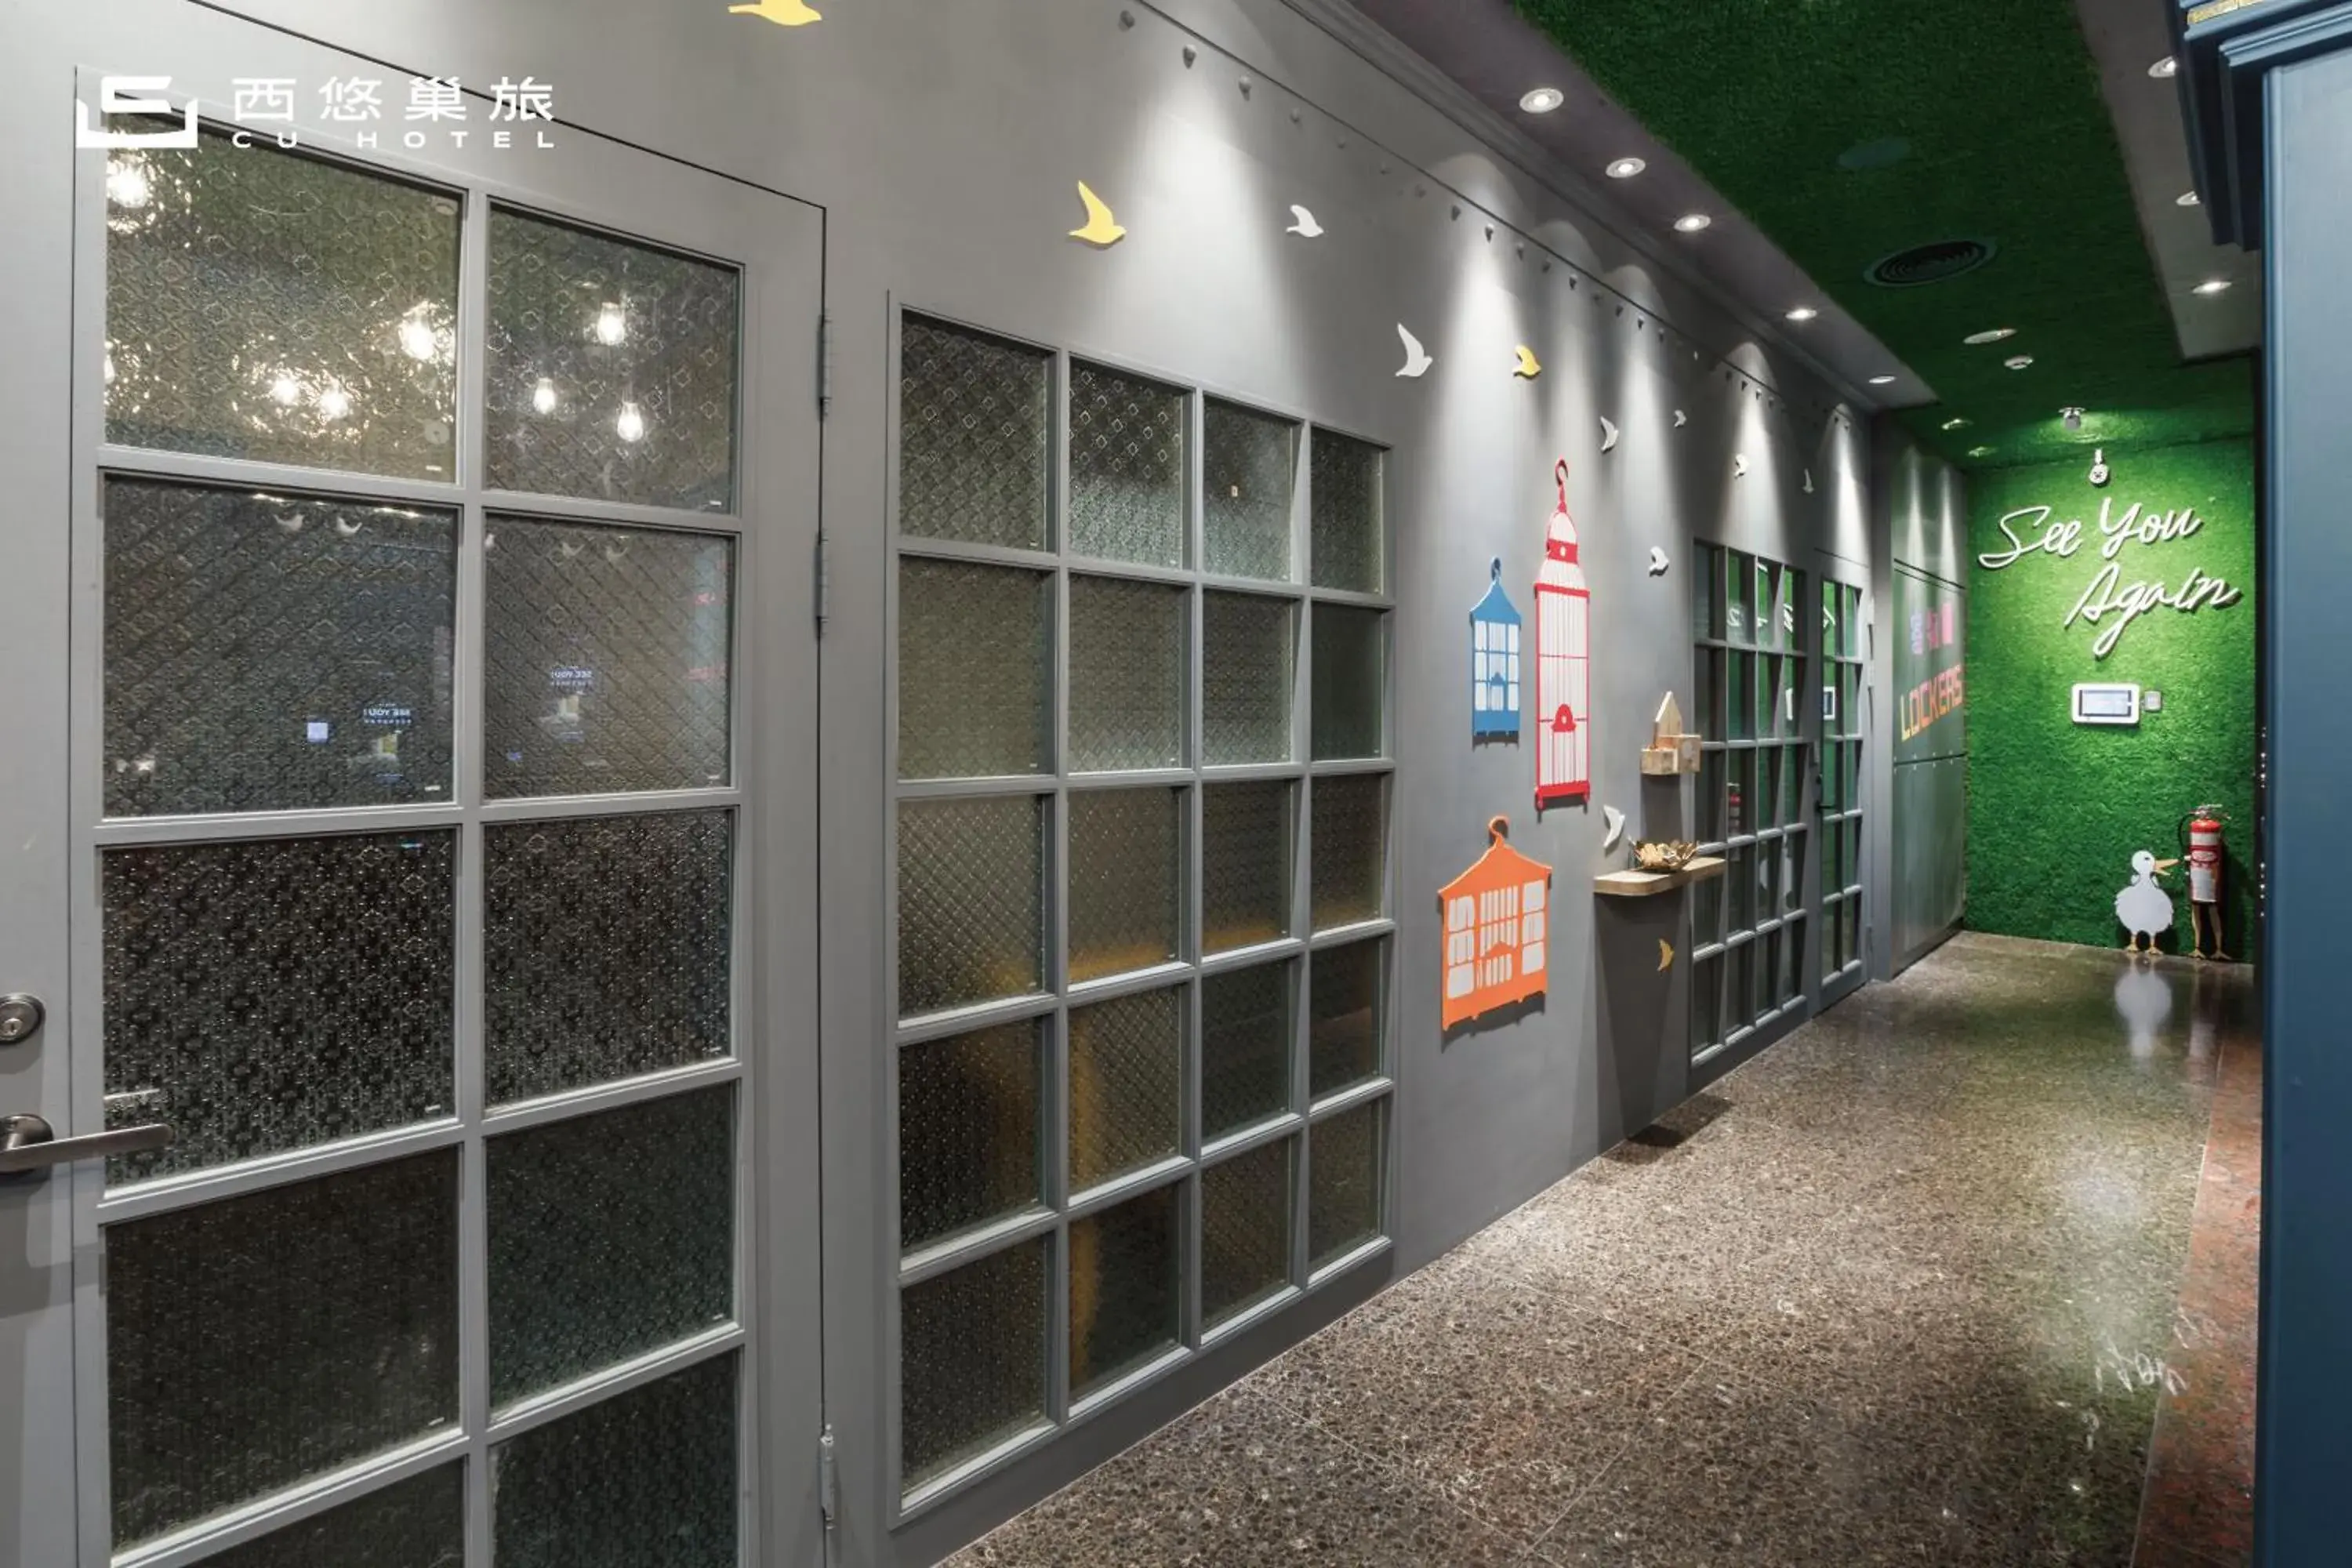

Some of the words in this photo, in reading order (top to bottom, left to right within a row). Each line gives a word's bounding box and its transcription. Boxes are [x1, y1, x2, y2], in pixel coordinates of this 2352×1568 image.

[1978, 505, 2084, 568] See
[2100, 497, 2202, 558] You
[2064, 563, 2241, 657] Again
[1900, 664, 1962, 742] LOCKERS
